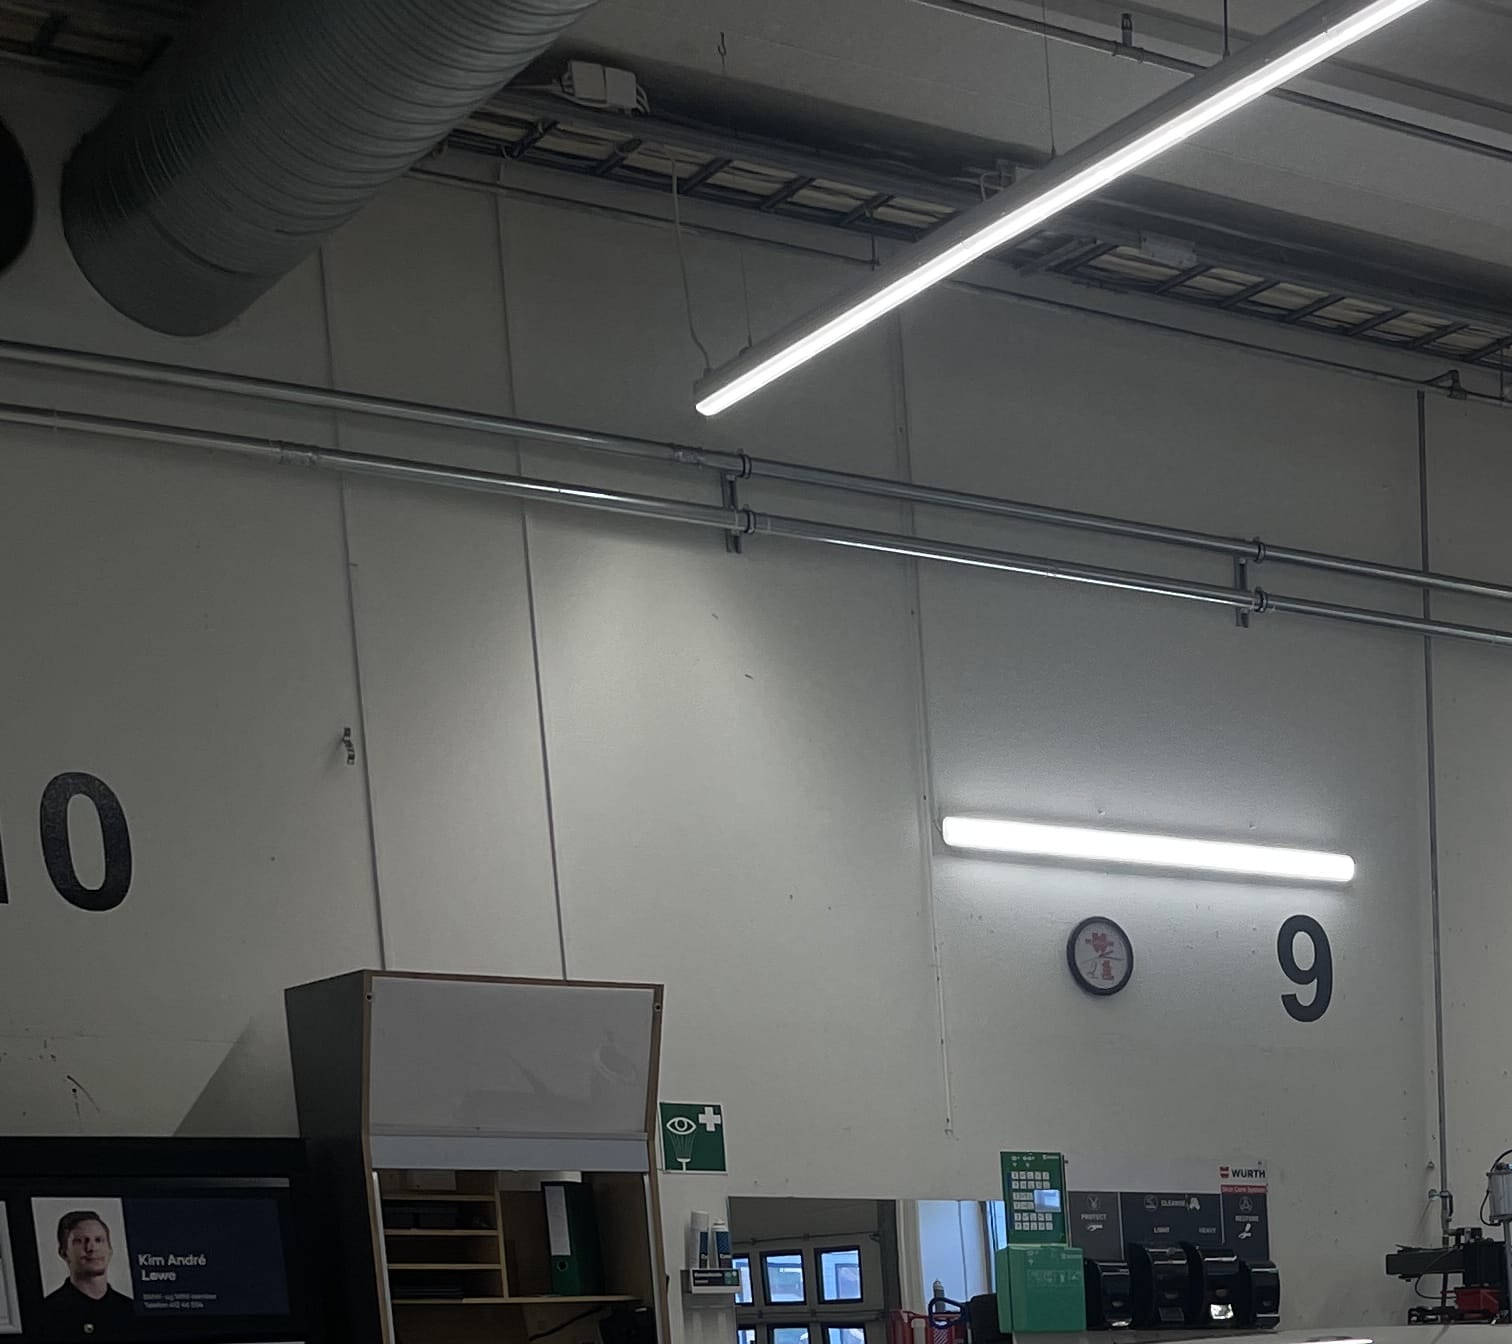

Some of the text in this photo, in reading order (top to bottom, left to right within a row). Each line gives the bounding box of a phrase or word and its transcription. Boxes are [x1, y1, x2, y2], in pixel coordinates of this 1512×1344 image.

[0, 771, 132, 911] 0
[1277, 915, 1333, 1022] 9
[137, 1253, 207, 1266] Kim André
